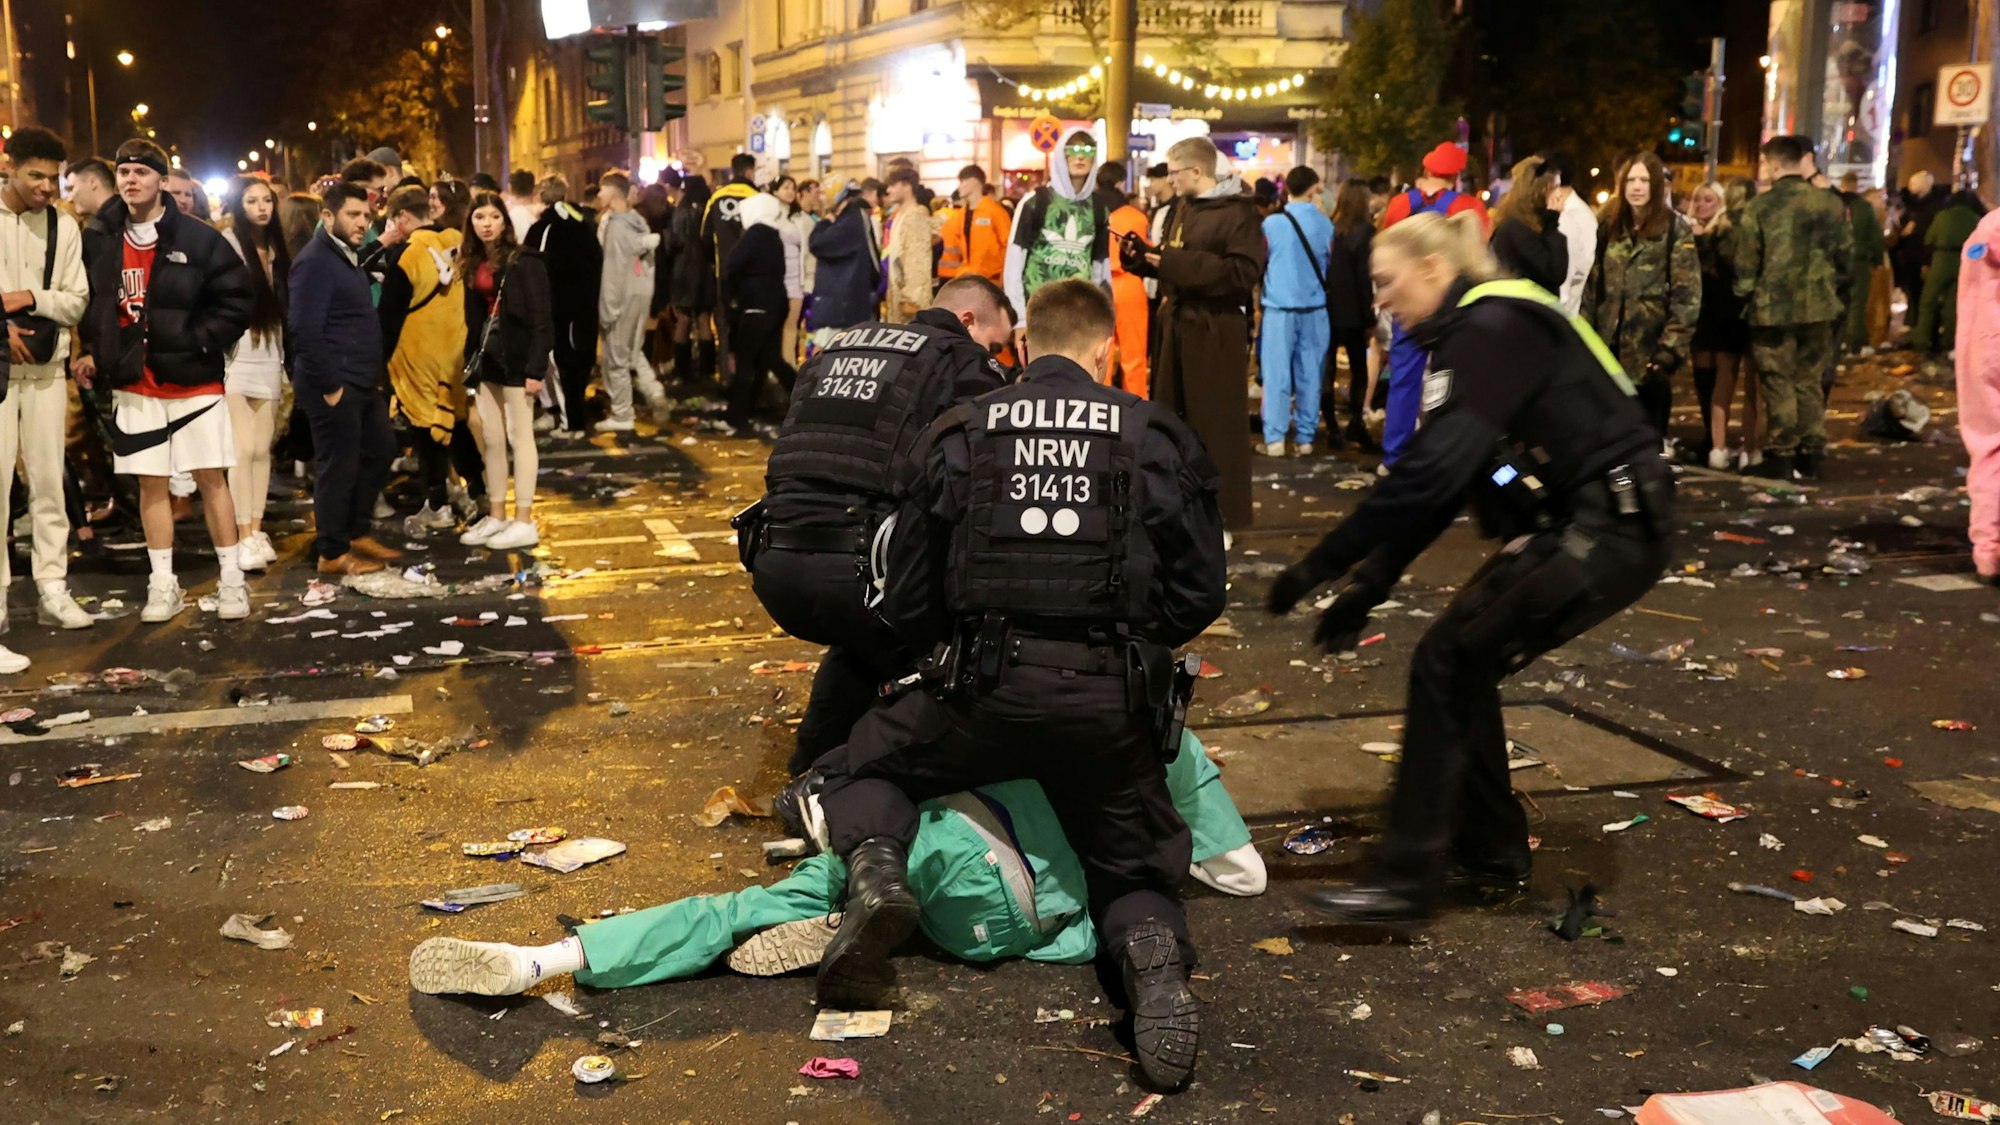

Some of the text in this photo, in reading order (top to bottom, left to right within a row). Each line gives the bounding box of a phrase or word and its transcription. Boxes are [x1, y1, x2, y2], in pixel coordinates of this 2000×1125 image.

[825, 328, 928, 352] POLIZEI
[829, 357, 887, 378] NRW
[817, 377, 879, 400] 31413
[987, 399, 1120, 433] POLIZEI
[1014, 438, 1091, 468] NRW
[1010, 473, 1091, 503] 31413
